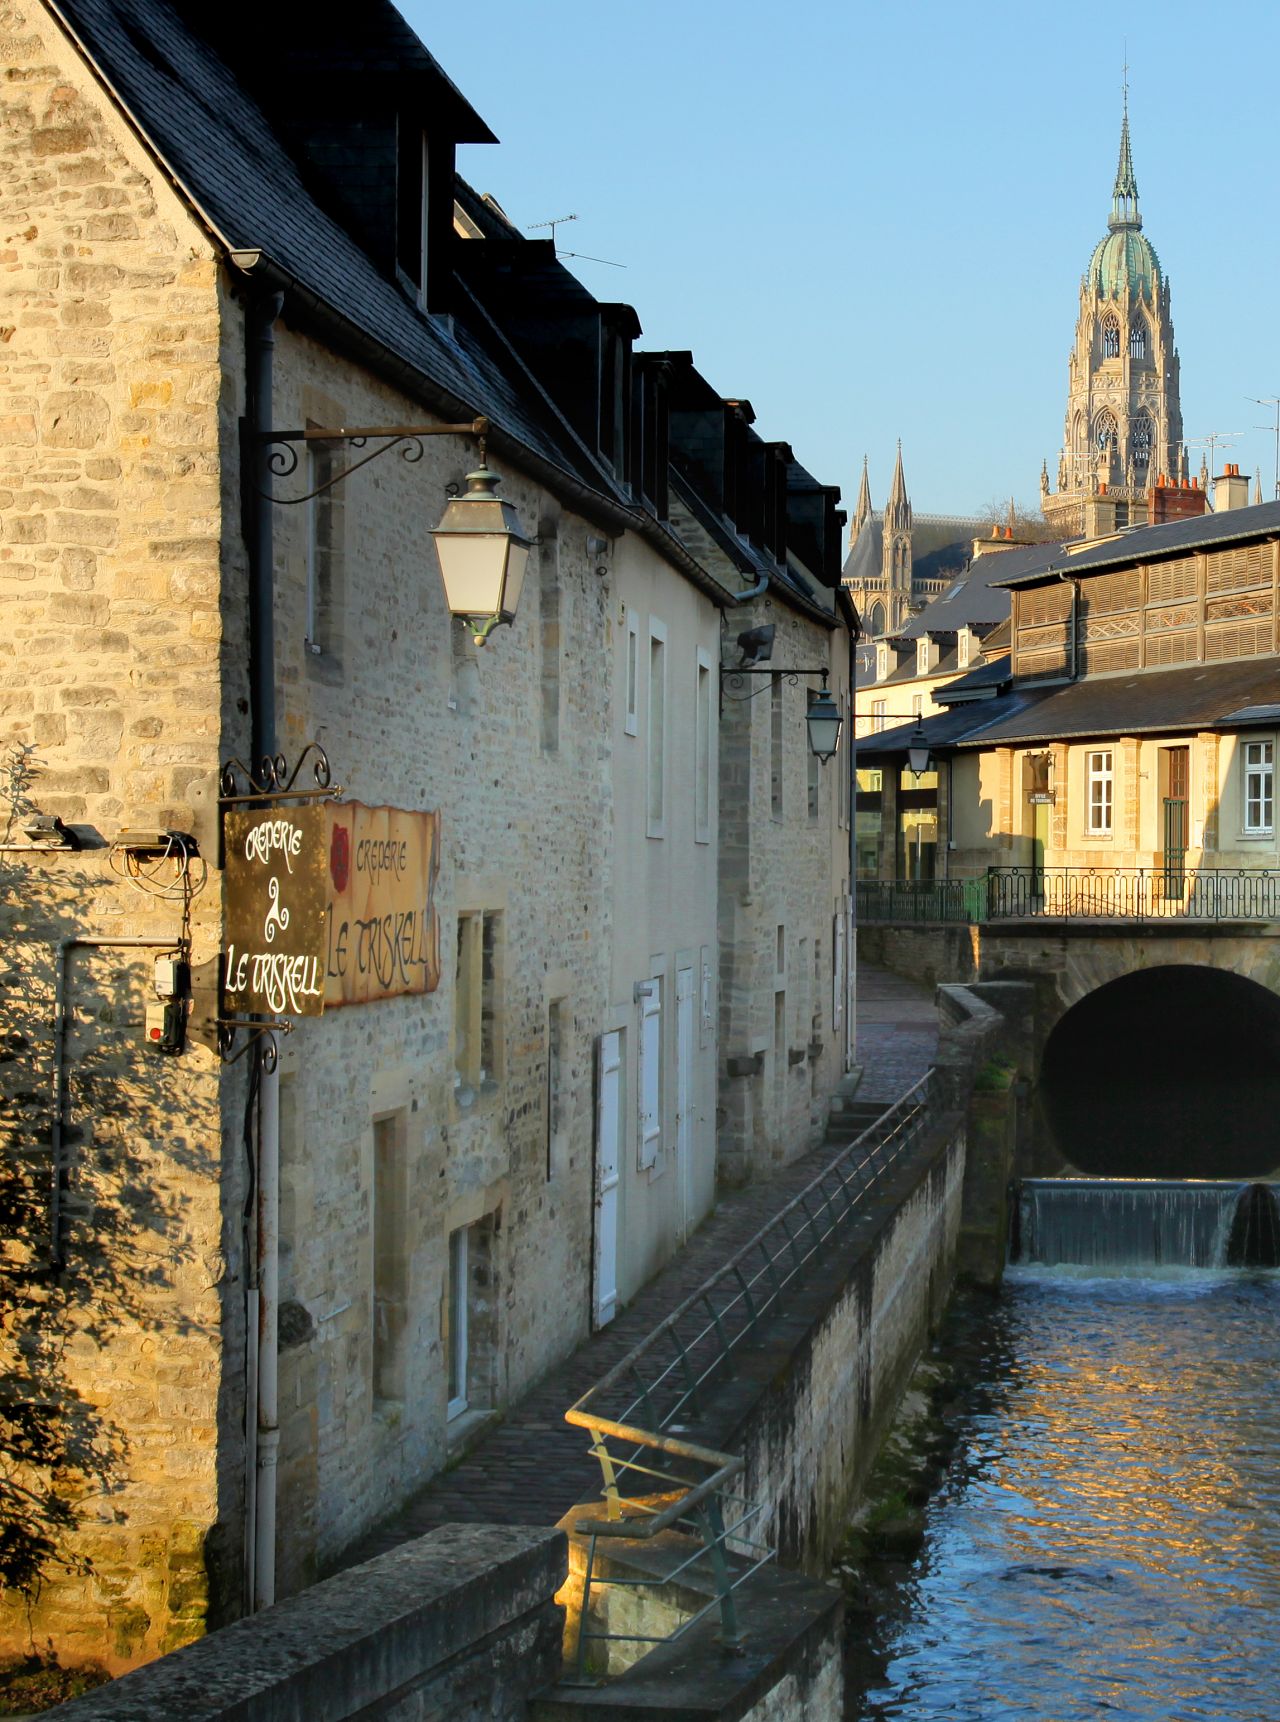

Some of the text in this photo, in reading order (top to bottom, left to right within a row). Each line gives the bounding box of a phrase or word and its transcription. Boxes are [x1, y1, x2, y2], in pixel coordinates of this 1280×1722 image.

[245, 820, 303, 875] CREPERIE
[356, 839, 407, 886] CREPERIE
[353, 910, 428, 989] TRISKELL
[251, 952, 321, 1014] TRISKELL
